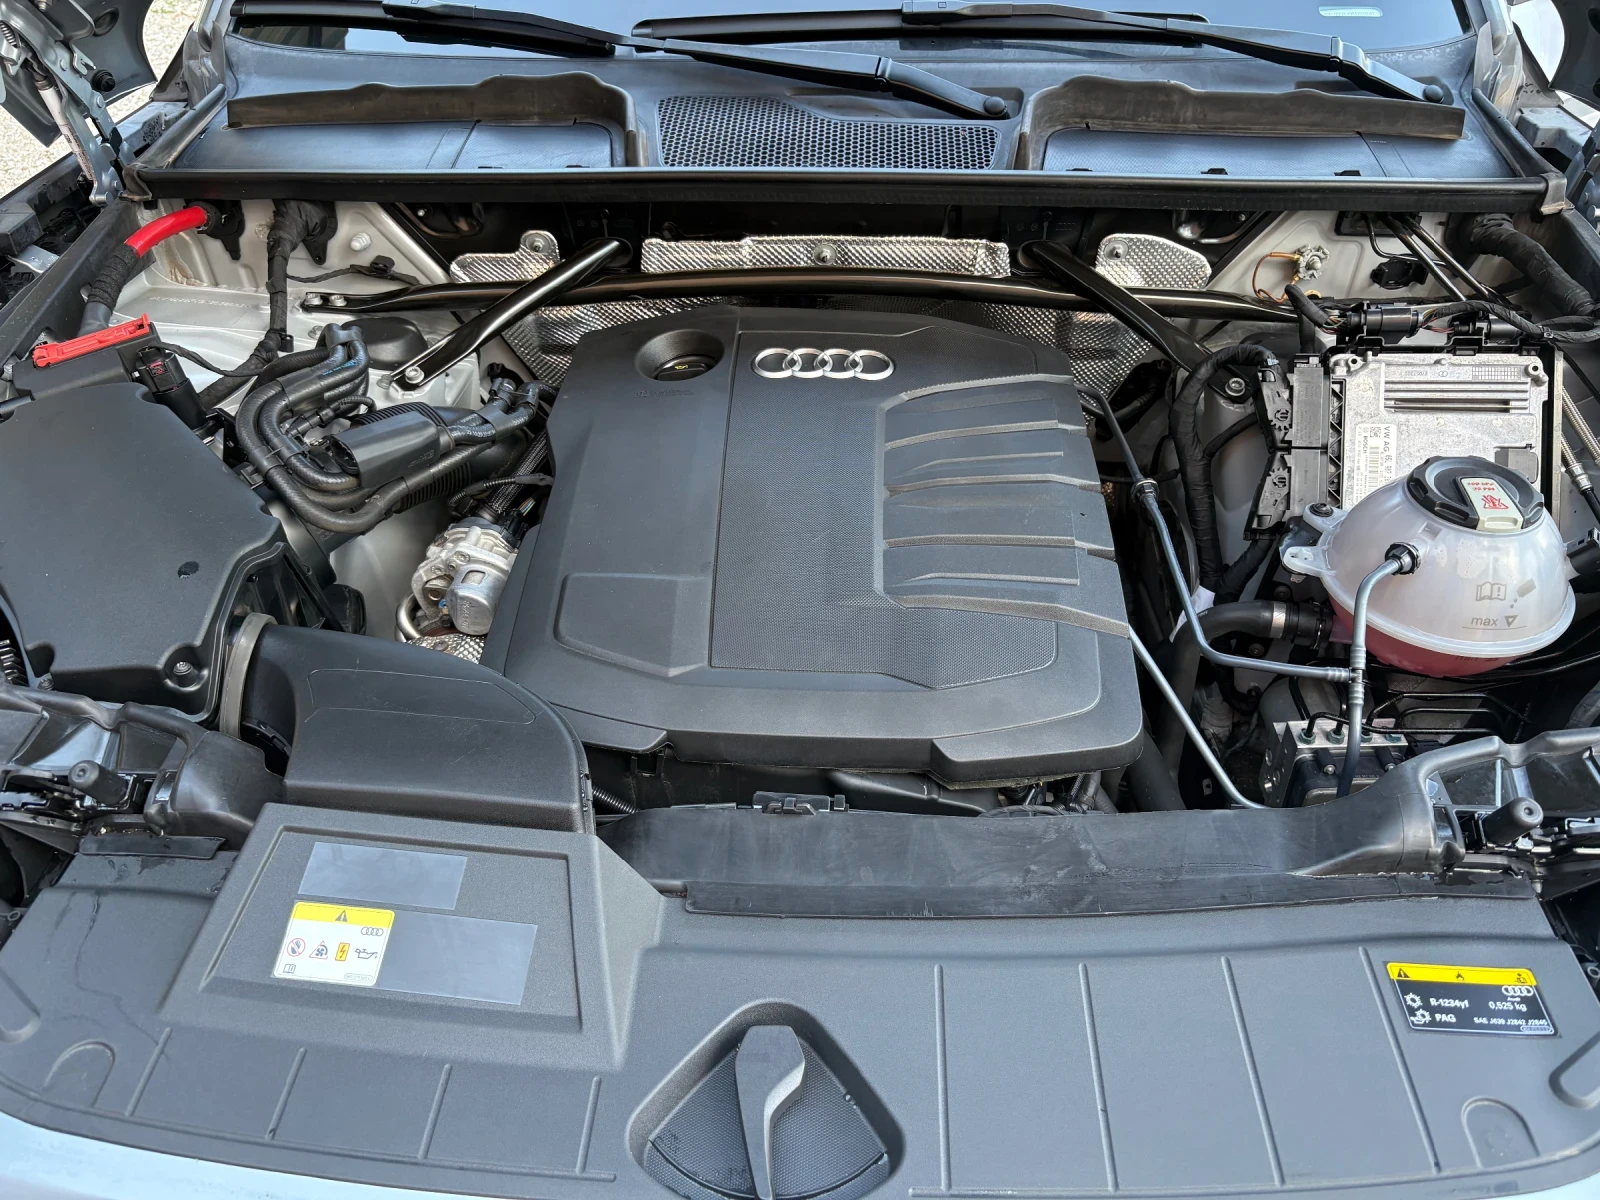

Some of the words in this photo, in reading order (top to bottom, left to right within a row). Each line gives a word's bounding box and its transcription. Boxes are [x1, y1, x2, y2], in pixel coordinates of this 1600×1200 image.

[1383, 426, 1390, 439] VW
[1383, 440, 1390, 452] AG
[1470, 617, 1499, 627] max
[1488, 1001, 1514, 1011] 0,525
[1514, 1002, 1527, 1012] kg
[1434, 1013, 1457, 1023] PAG
[1473, 1016, 1489, 1025] SAE
